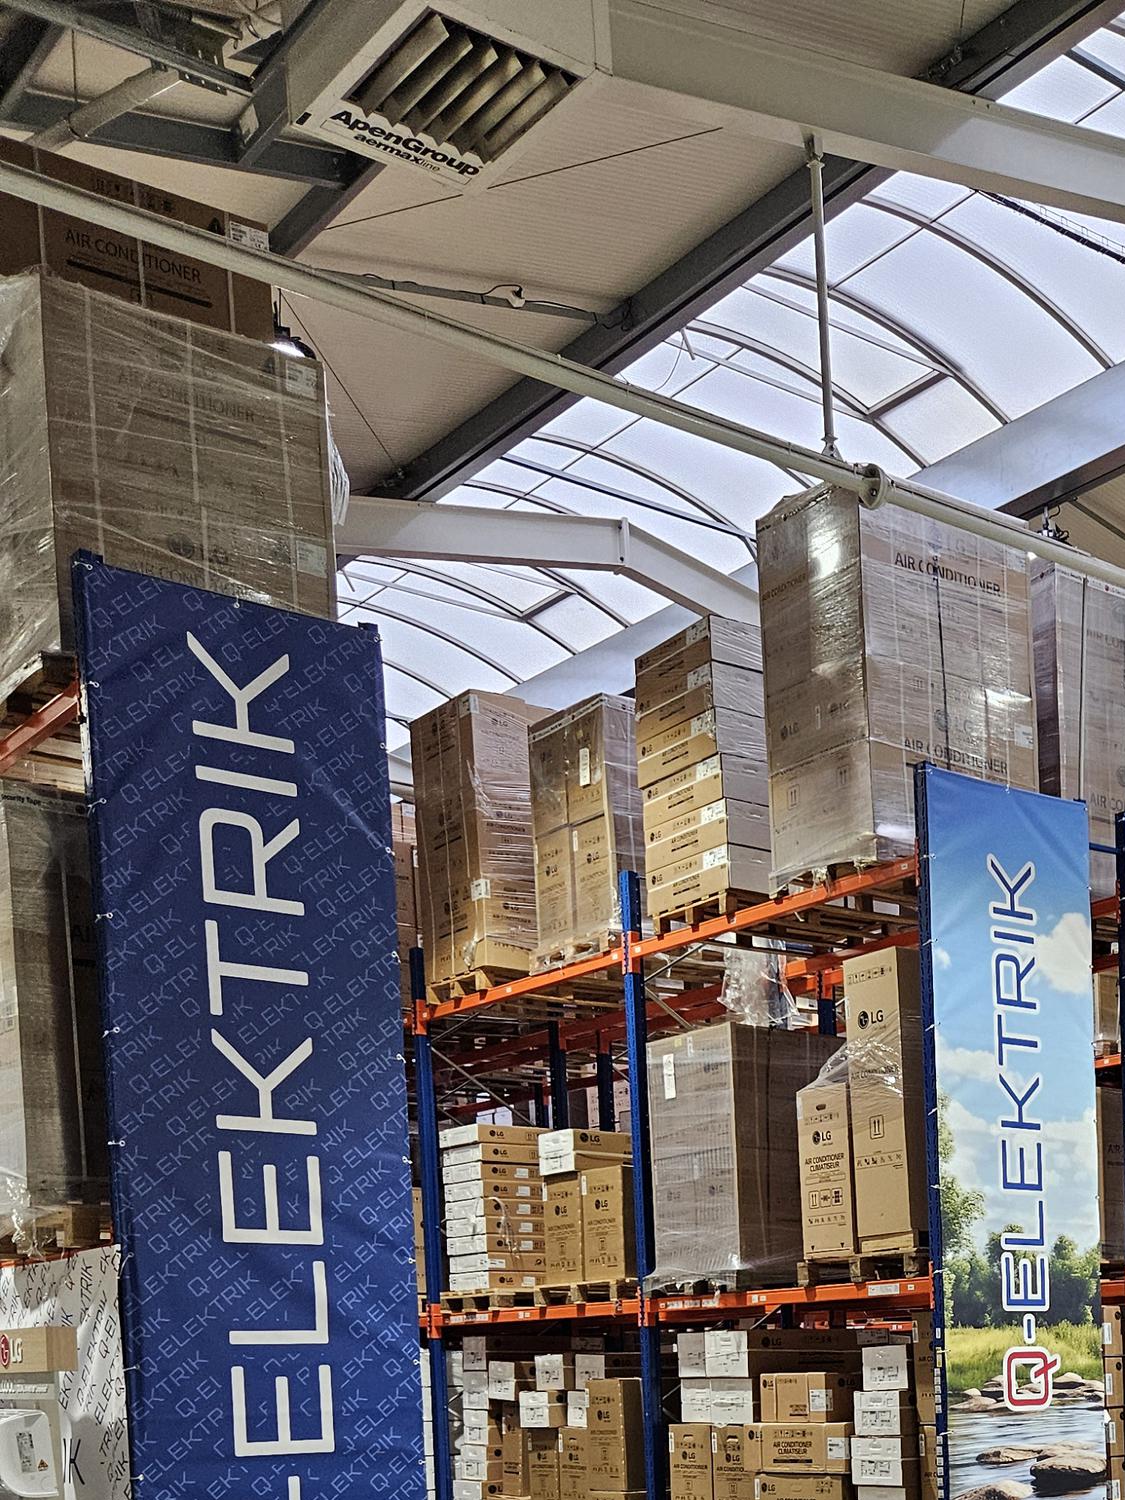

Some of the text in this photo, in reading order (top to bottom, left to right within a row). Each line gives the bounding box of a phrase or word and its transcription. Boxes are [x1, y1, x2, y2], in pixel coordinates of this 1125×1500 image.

[330, 110, 480, 176] ApenGroup
[65, 229, 202, 284] AIR CONDITIONER
[894, 552, 1001, 597] AIR CONDITIONER
[904, 737, 924, 752] AIR
[1090, 793, 1107, 809] AIR
[871, 1010, 884, 1024] LG
[822, 1131, 832, 1142] LG
[986, 853, 1061, 1412] Q-ELEKTRIK
[590, 1135, 600, 1143] LG
[804, 1153, 844, 1166] AIR CONDITIONER
[810, 1161, 840, 1172] CLIMATISEUR
[560, 1206, 567, 1214] LG
[772, 1338, 782, 1346] LG
[10, 1338, 23, 1363] LG
[603, 1410, 610, 1420] LG
[688, 1452, 696, 1461] LG
[732, 1454, 740, 1462] LG
[768, 1484, 776, 1492] LG
